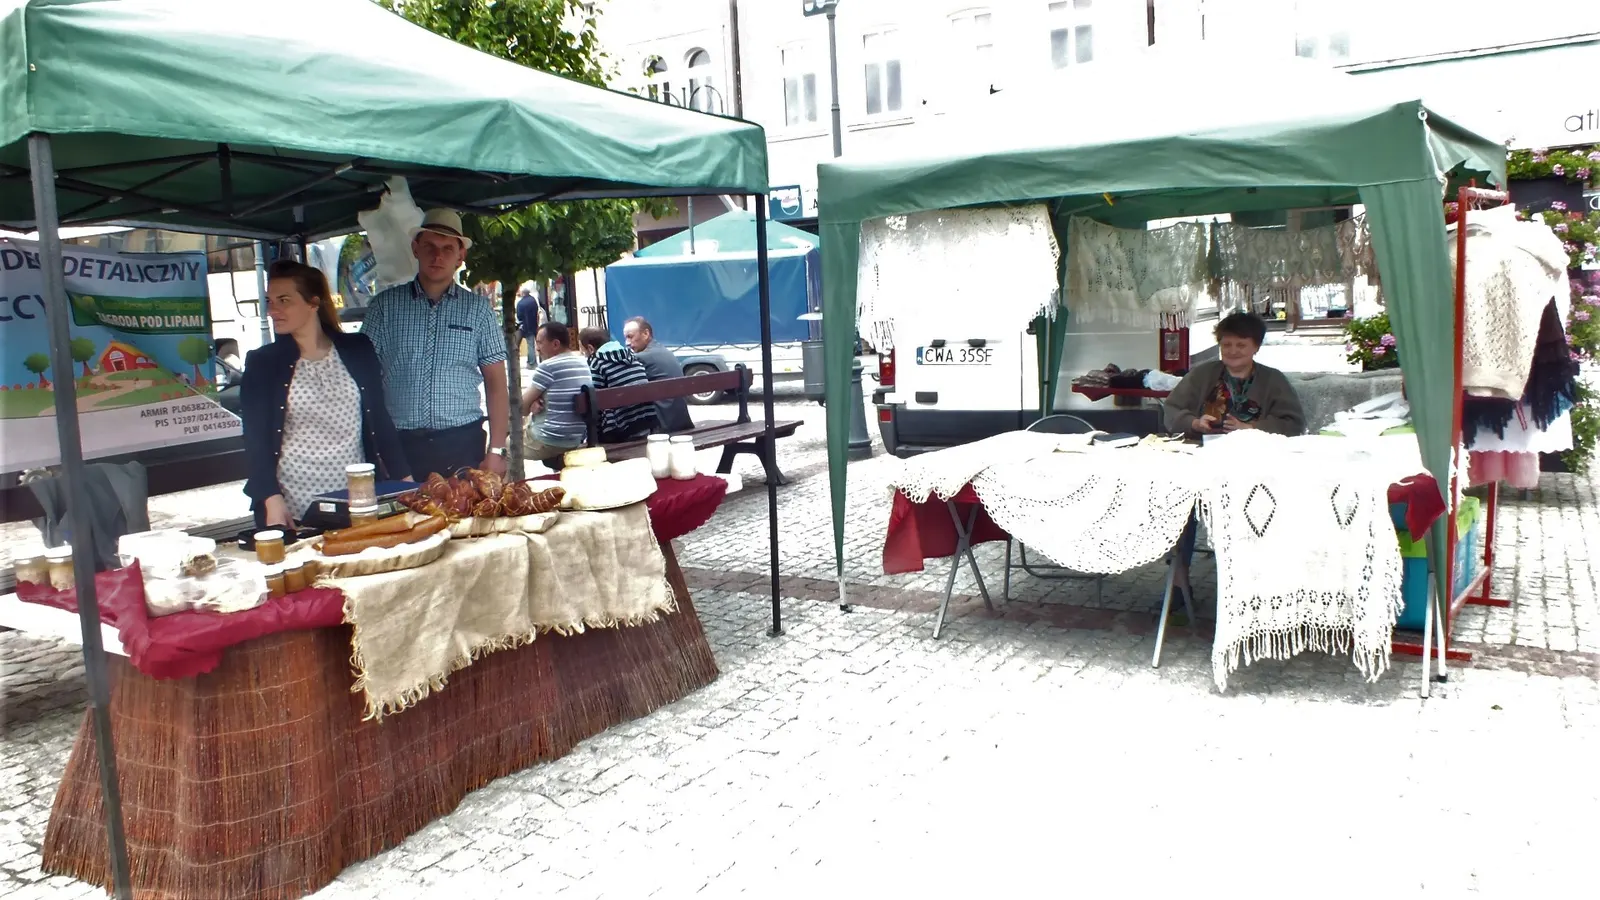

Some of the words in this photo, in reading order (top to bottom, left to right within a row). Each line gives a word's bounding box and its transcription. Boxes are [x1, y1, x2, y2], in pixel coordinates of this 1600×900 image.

[62, 255, 200, 283] DETALICZNY
[141, 315, 162, 328] POD
[164, 315, 205, 328] LIPAMI
[925, 348, 954, 363] CWA
[959, 348, 993, 363] 35SF
[140, 407, 168, 418] ARMIR
[155, 418, 169, 428] PIS
[184, 425, 200, 435] PLW
